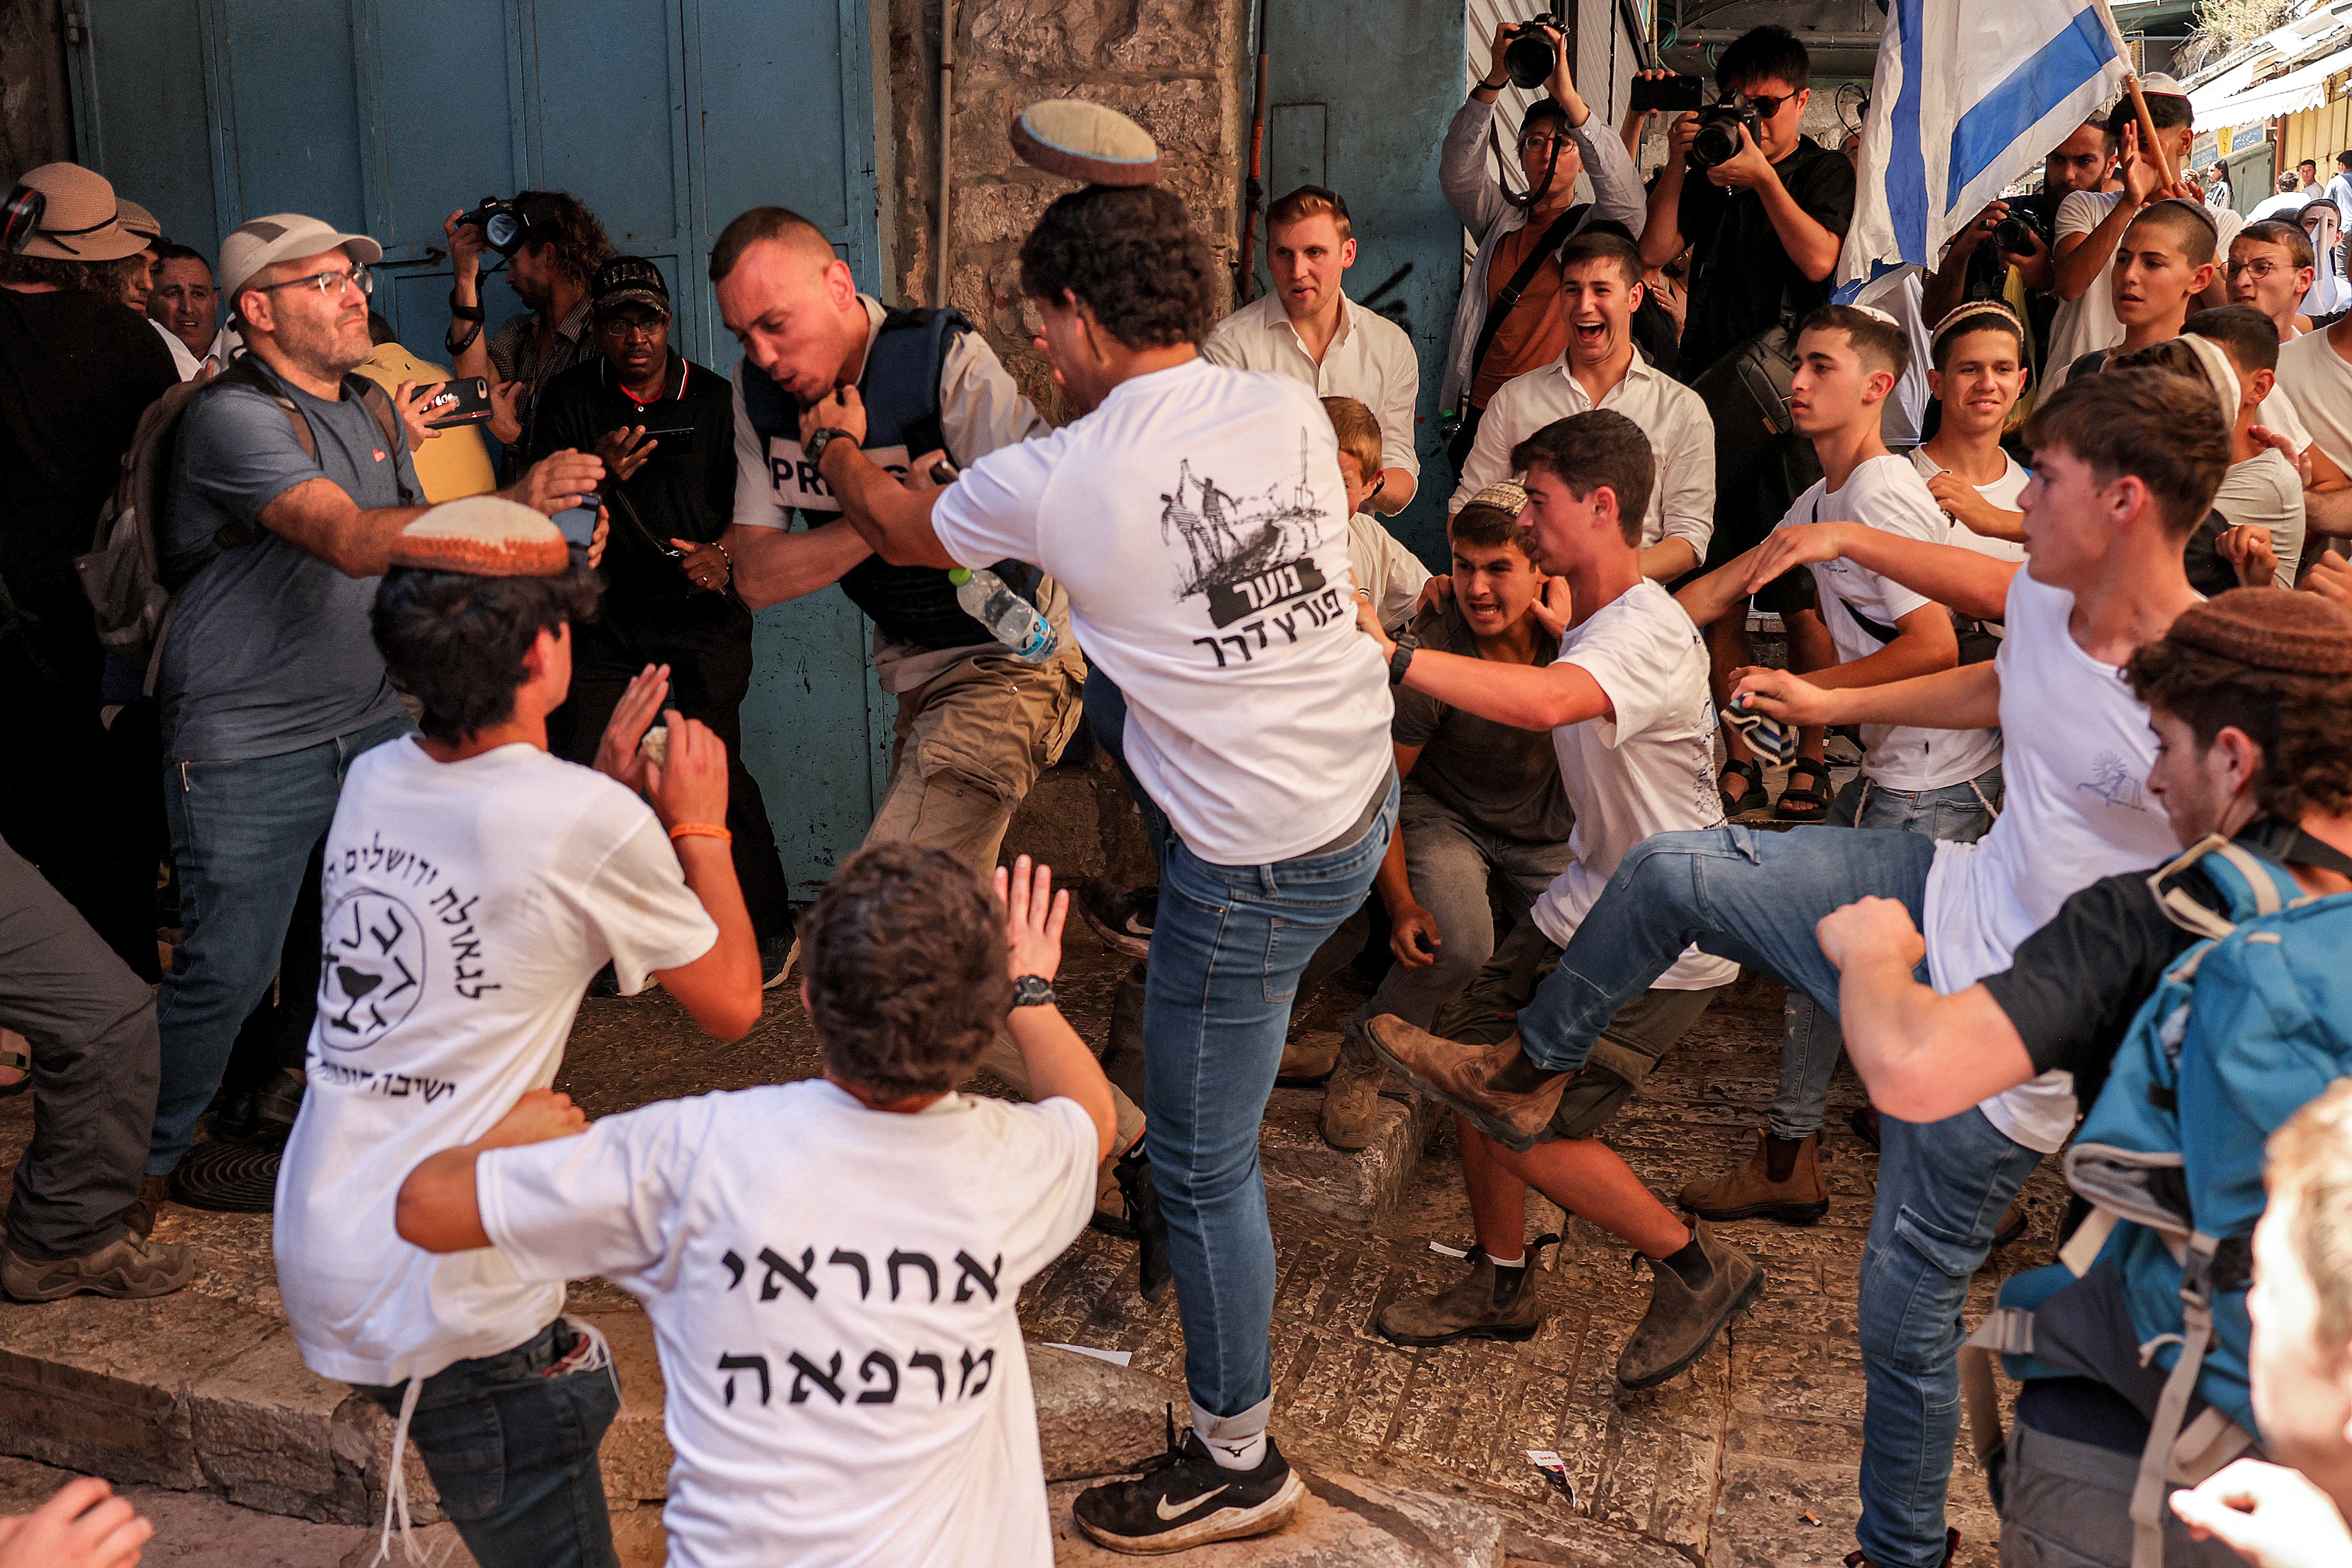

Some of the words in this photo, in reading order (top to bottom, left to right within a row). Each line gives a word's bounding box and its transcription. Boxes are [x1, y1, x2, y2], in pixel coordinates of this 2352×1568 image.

[1232, 564, 1304, 610] נוער
[1193, 620, 1267, 667] דרך
[1273, 589, 1343, 644] פורץ
[346, 829, 438, 887] ירושלים
[430, 886, 501, 1000] לגאולת
[722, 1246, 1002, 1303] אחראי
[717, 1348, 994, 1406] מרפאה
